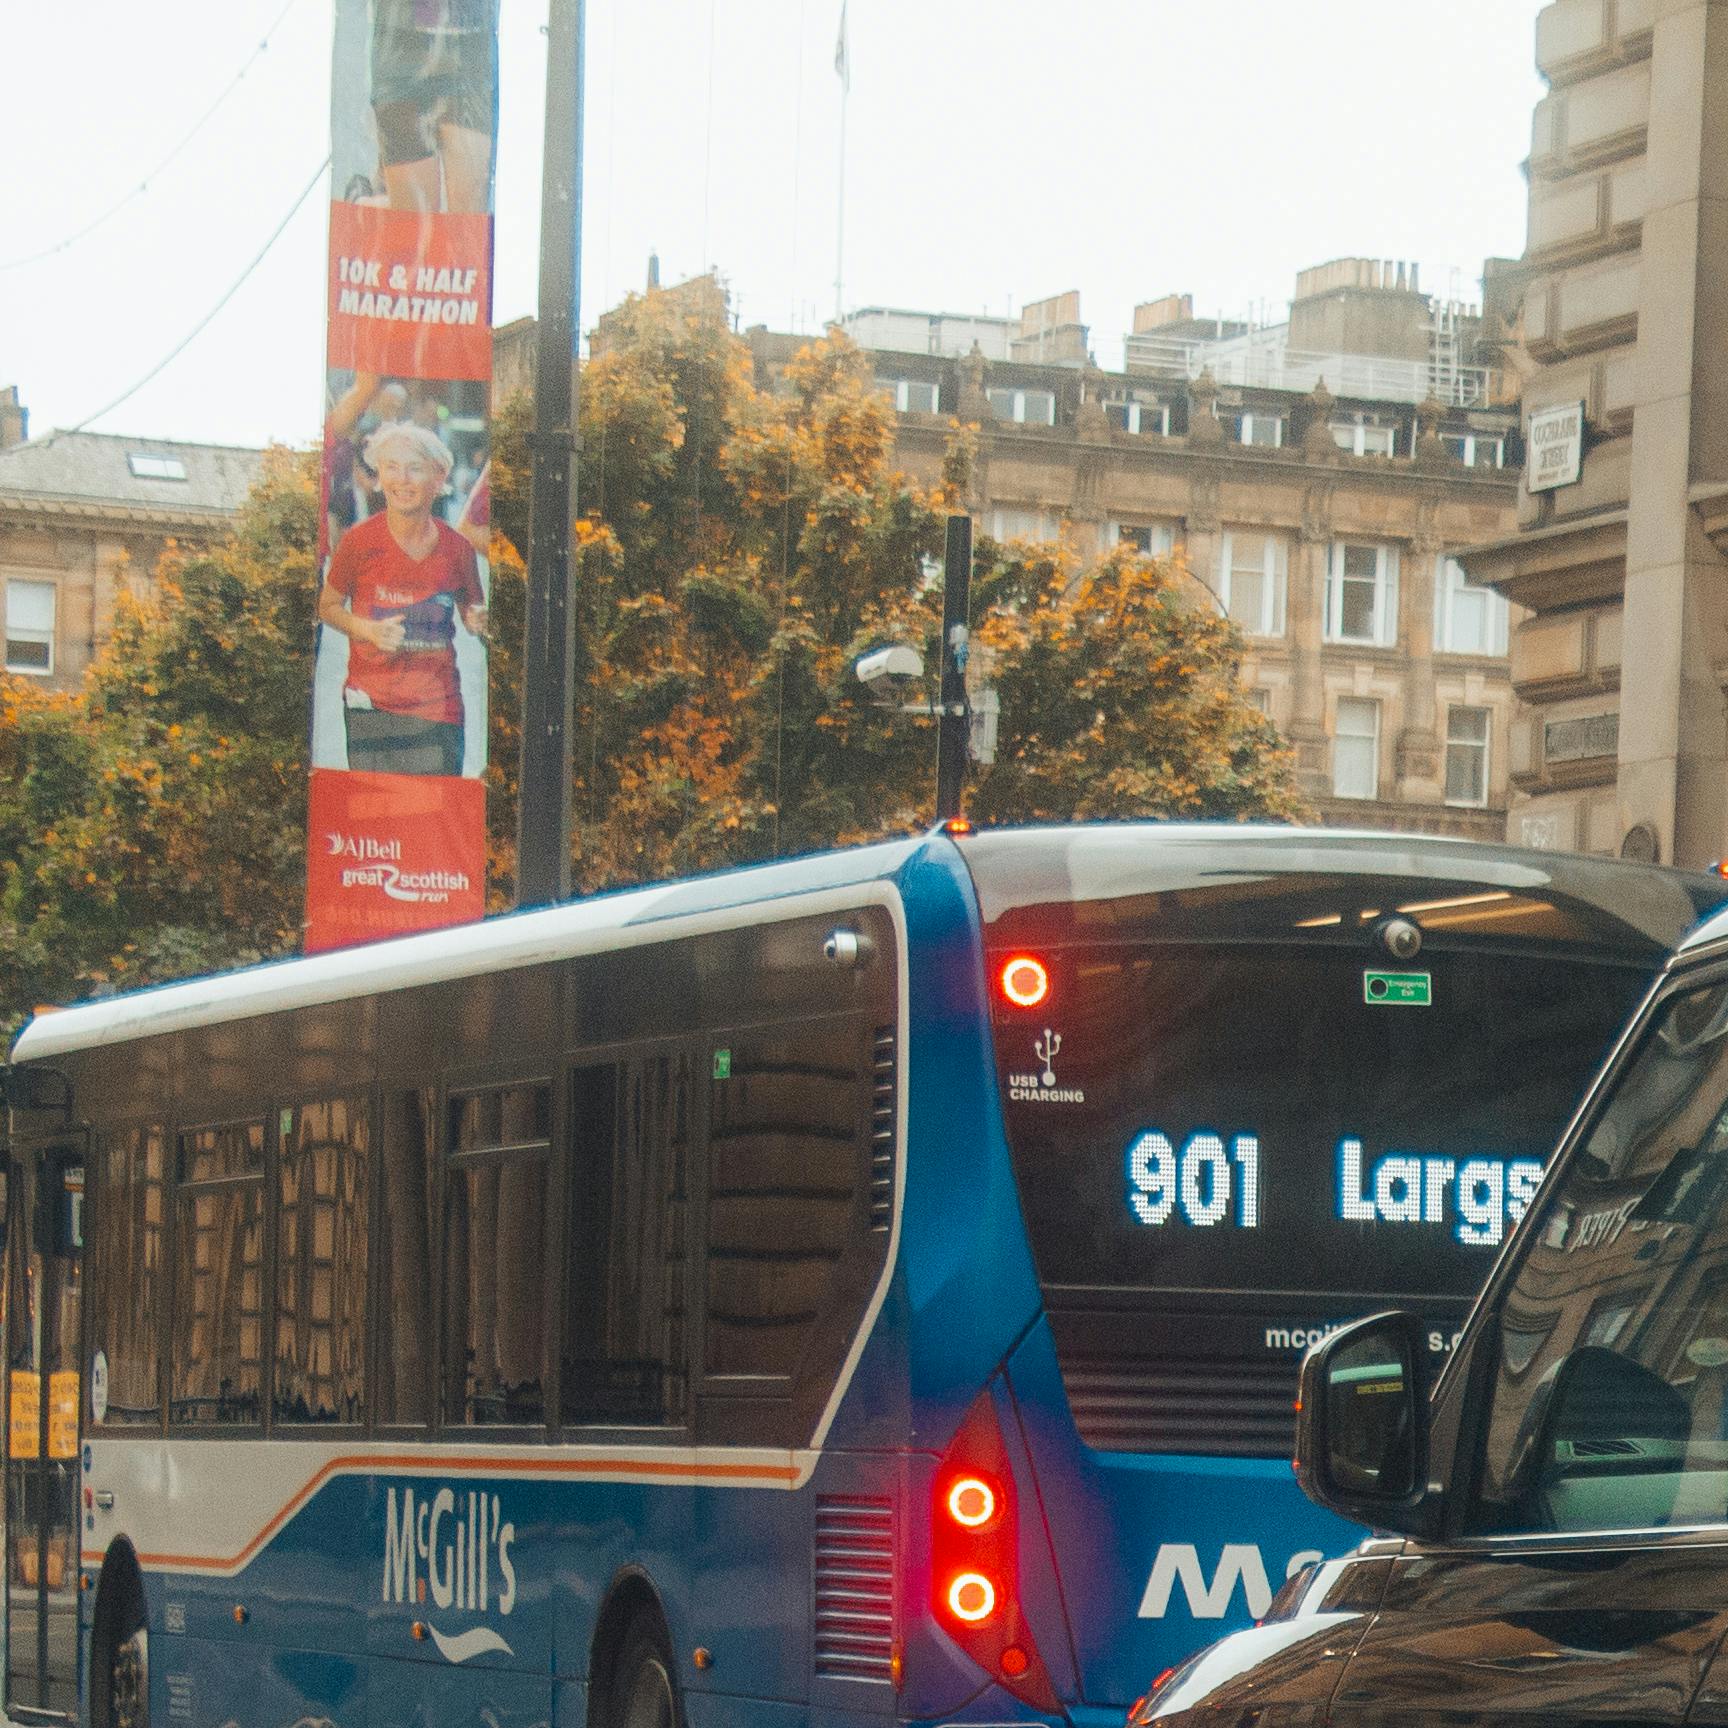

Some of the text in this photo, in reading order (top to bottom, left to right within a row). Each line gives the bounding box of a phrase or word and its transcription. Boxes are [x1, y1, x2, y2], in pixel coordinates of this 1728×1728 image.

[339, 256, 477, 294] 10K & HALF
[338, 288, 478, 325] MARATHON
[342, 869, 469, 891] great scottish
[419, 891, 449, 903] run
[1009, 1074, 1039, 1088] USB
[1009, 1088, 1085, 1103] CHARGING
[1129, 1131, 1546, 1246] 901 Largs
[383, 1487, 517, 1616] McGill's
